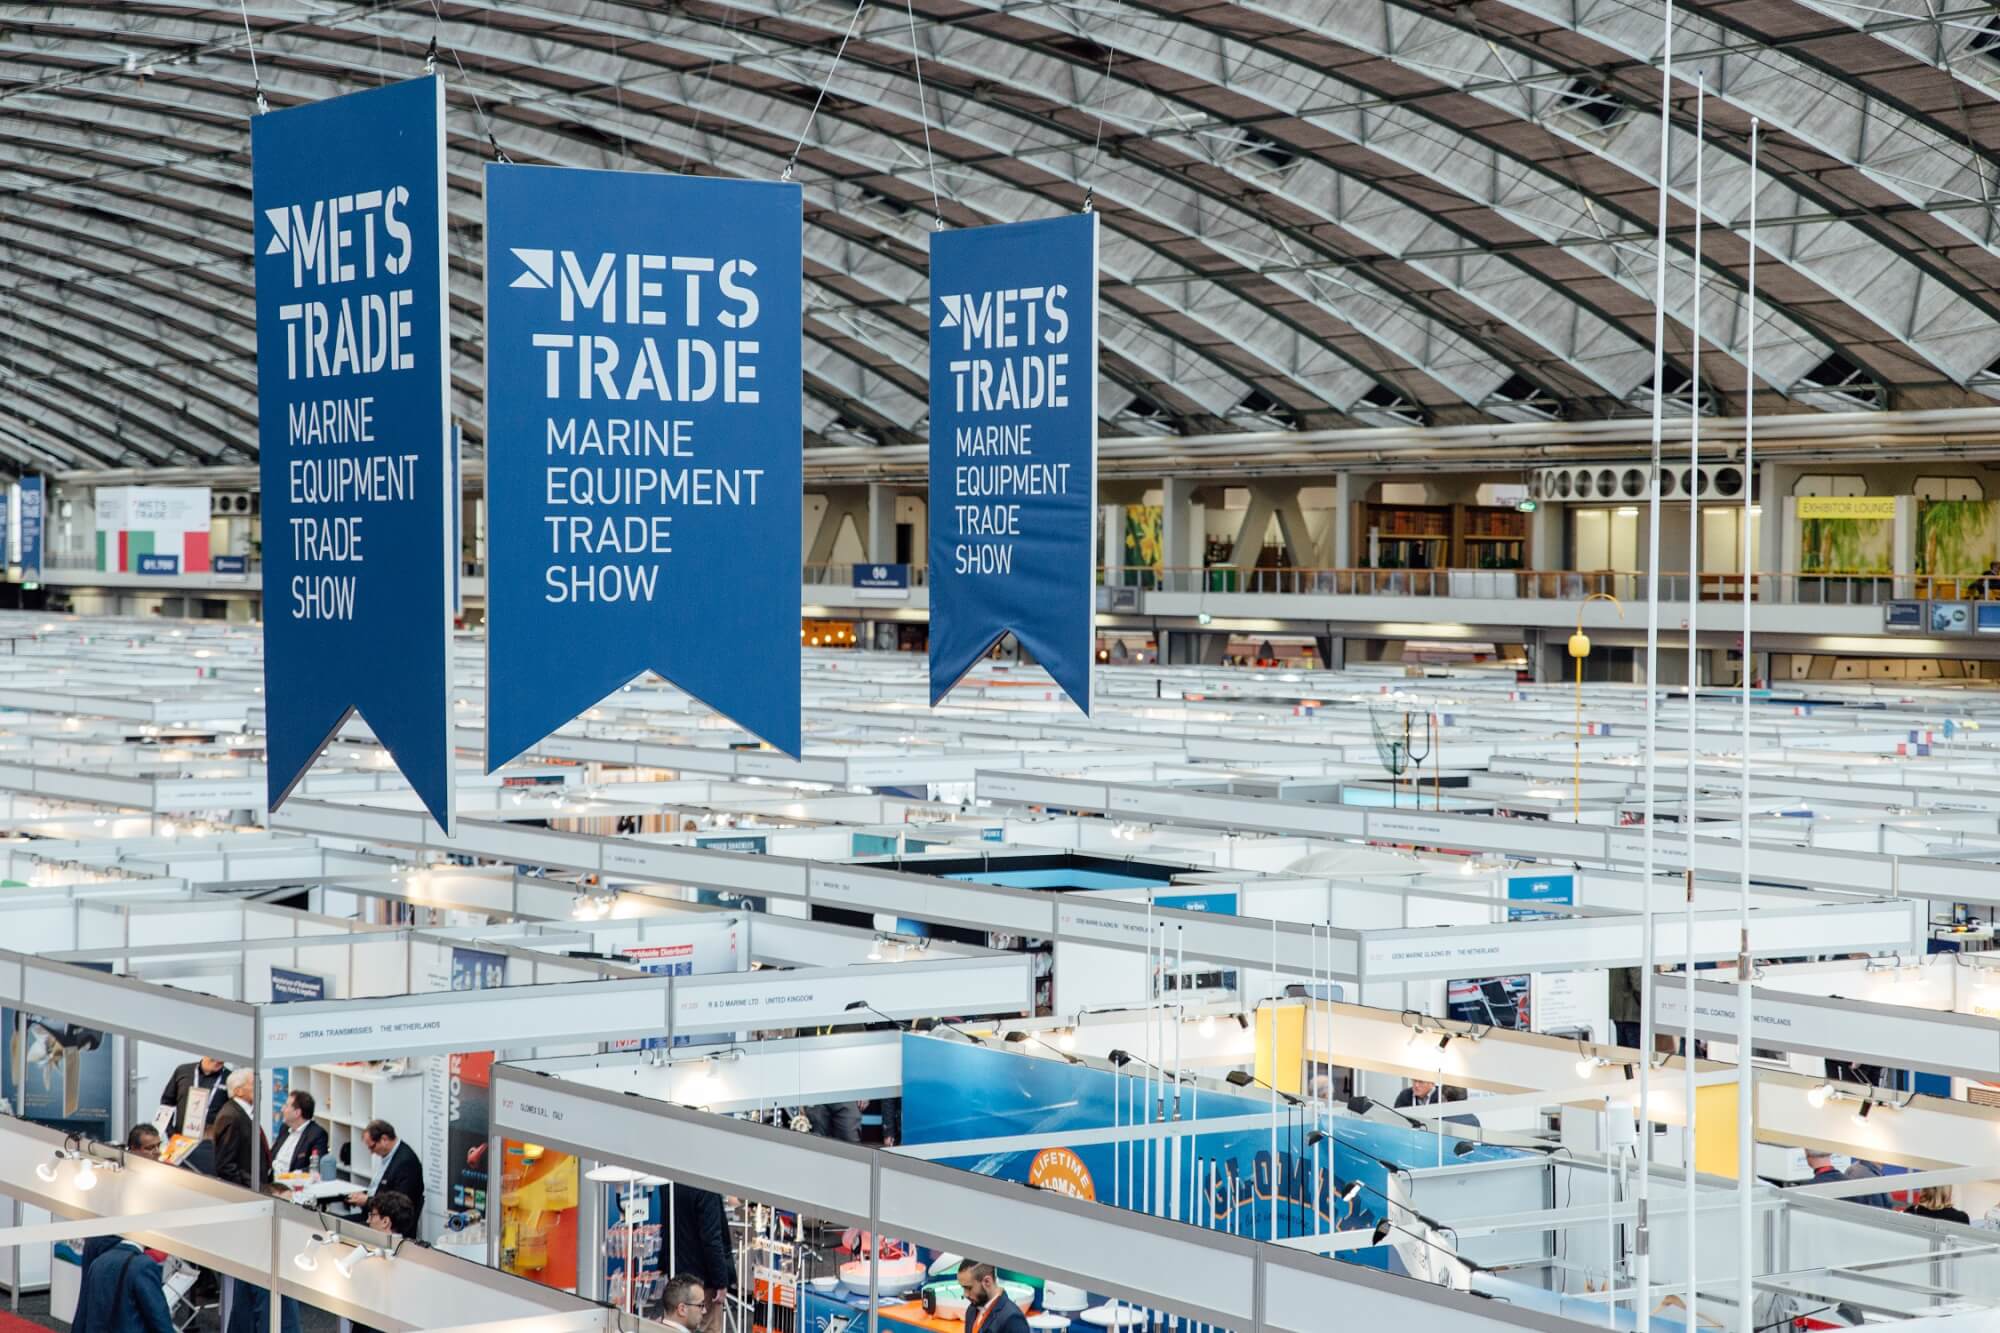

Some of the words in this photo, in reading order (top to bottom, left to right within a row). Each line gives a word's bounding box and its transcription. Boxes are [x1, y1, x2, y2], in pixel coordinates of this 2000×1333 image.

[292, 187, 412, 287] METS
[560, 250, 760, 328] METS
[280, 290, 414, 380] TRADE
[963, 285, 1069, 351] METS
[533, 334, 760, 403] TRADE
[951, 354, 1069, 413] TRADE
[290, 398, 374, 446] MARINE
[547, 418, 694, 457] MARINE
[956, 425, 1032, 457] MARINE
[291, 455, 418, 504] EQUIPMENT
[547, 467, 764, 506] EQUIPMENT
[956, 464, 1071, 497] EQUIPMENT
[955, 505, 1020, 535] TRADE
[1803, 502, 1852, 513] EXHIBITOR
[1854, 502, 1895, 513] LOUNGE
[291, 517, 363, 561] TRADE
[545, 516, 672, 553] TRADE
[955, 544, 1013, 575] SHOW
[292, 576, 356, 620] SHOW
[545, 565, 659, 603] SHOW
[725, 999, 746, 1008] MARINE
[748, 998, 759, 1006] LTD
[765, 996, 785, 1004] UNITED
[787, 994, 813, 1004] KINGDOM
[1710, 1008, 1736, 1019] COATINGS
[1753, 1015, 1791, 1026] NETHERLANDS
[326, 1026, 373, 1037] TRANSMISSIES
[380, 1023, 392, 1033] THE
[394, 1021, 441, 1032] NETHERLANDS
[1033, 1151, 1090, 1189] LIFETIME
